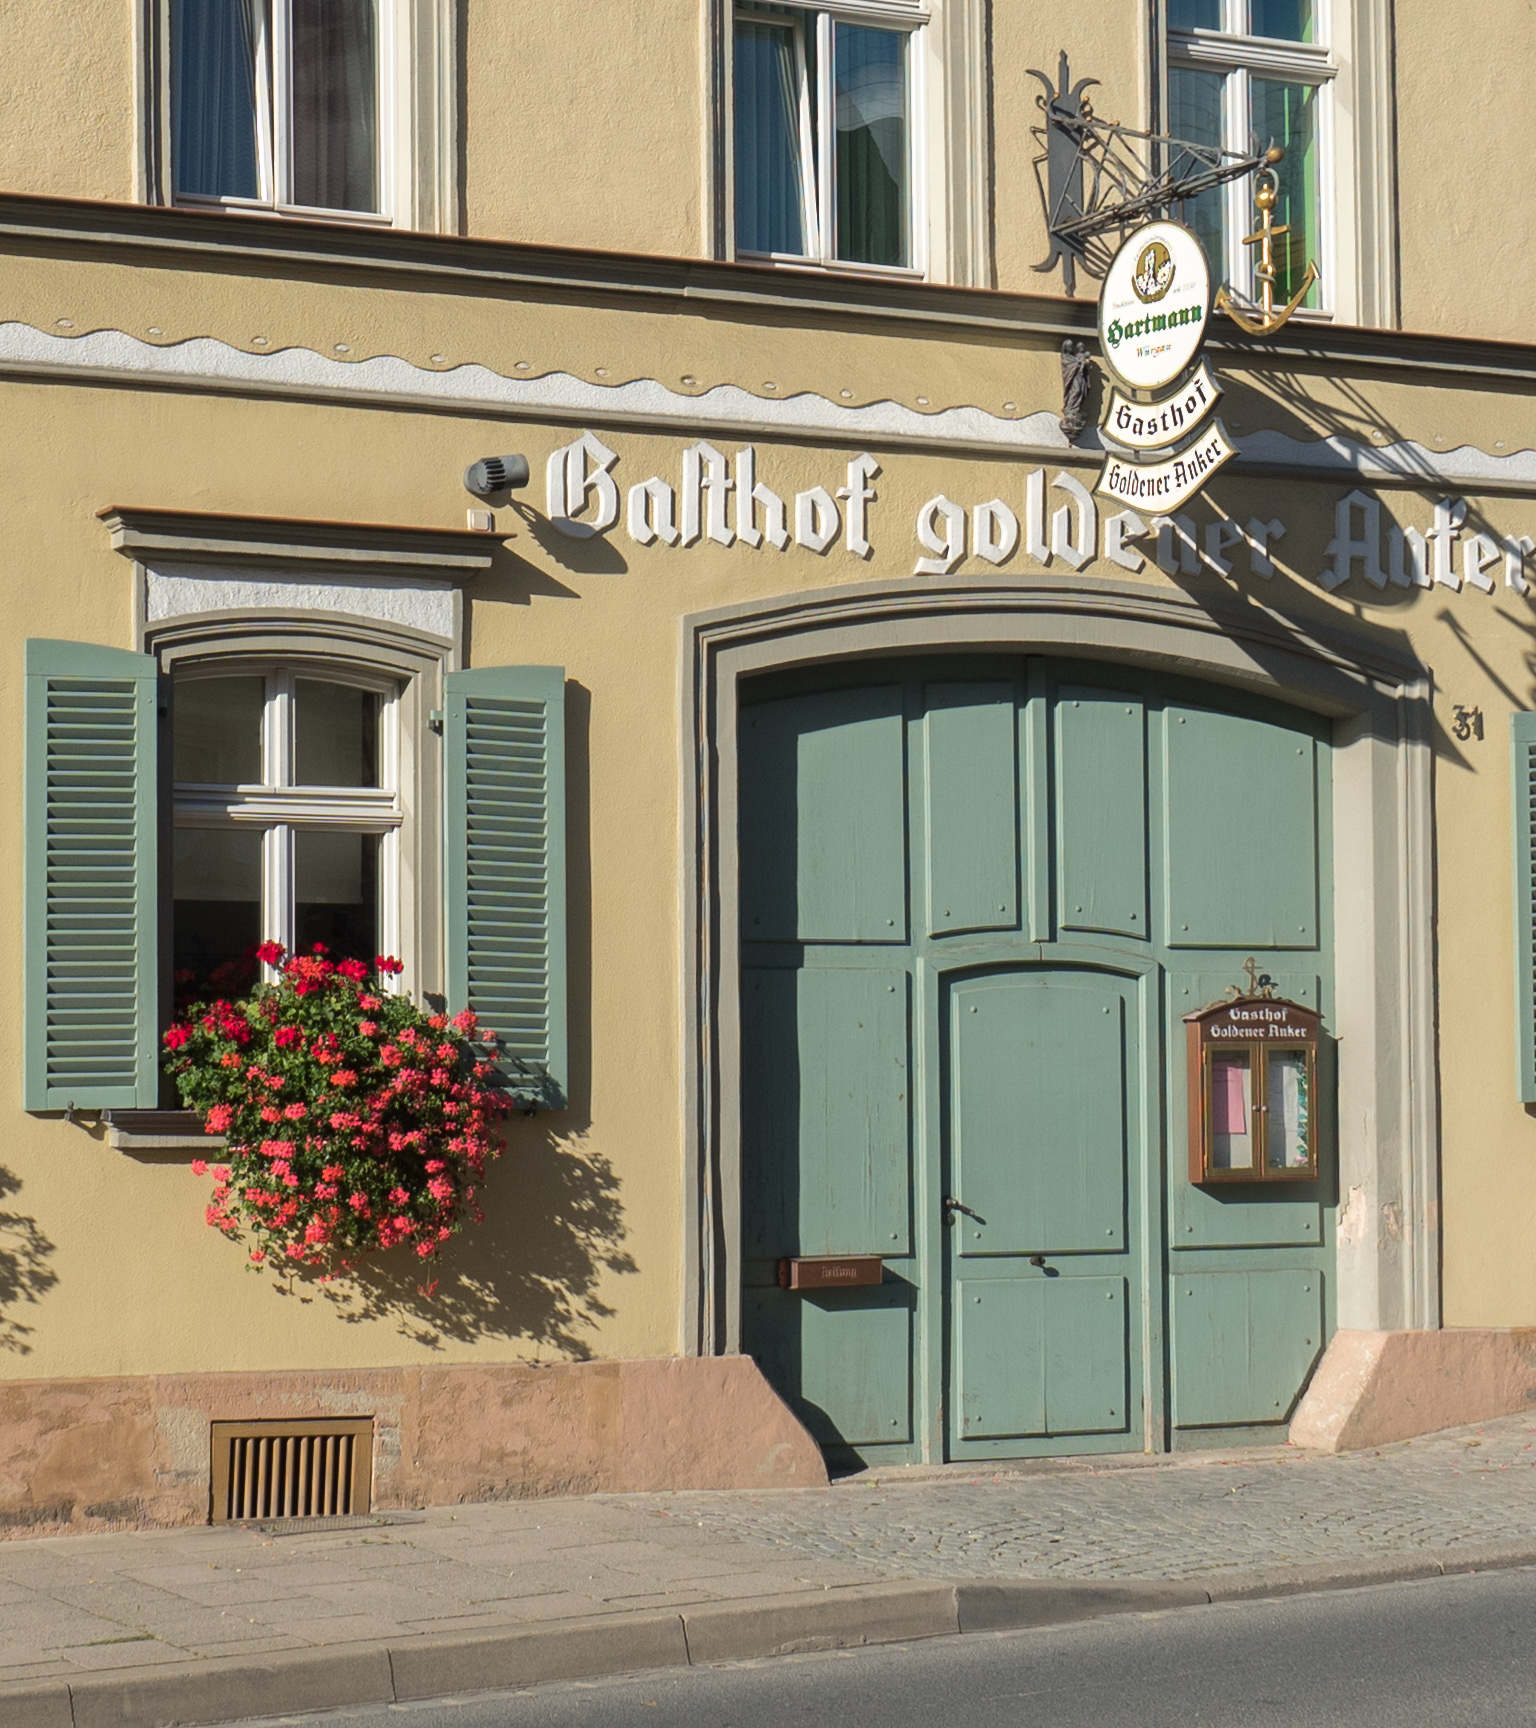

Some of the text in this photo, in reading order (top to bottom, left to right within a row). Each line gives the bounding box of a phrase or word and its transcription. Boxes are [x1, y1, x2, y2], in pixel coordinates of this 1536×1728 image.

[1107, 303, 1202, 349] Hartmann
[1115, 378, 1207, 436] Gasthof
[1109, 438, 1221, 498] Goldener Anker
[912, 467, 1287, 579] goldener
[1451, 704, 1482, 738] 31
[1210, 1023, 1308, 1038] Goldener Anker
[1228, 1007, 1288, 1022] Gasthof
